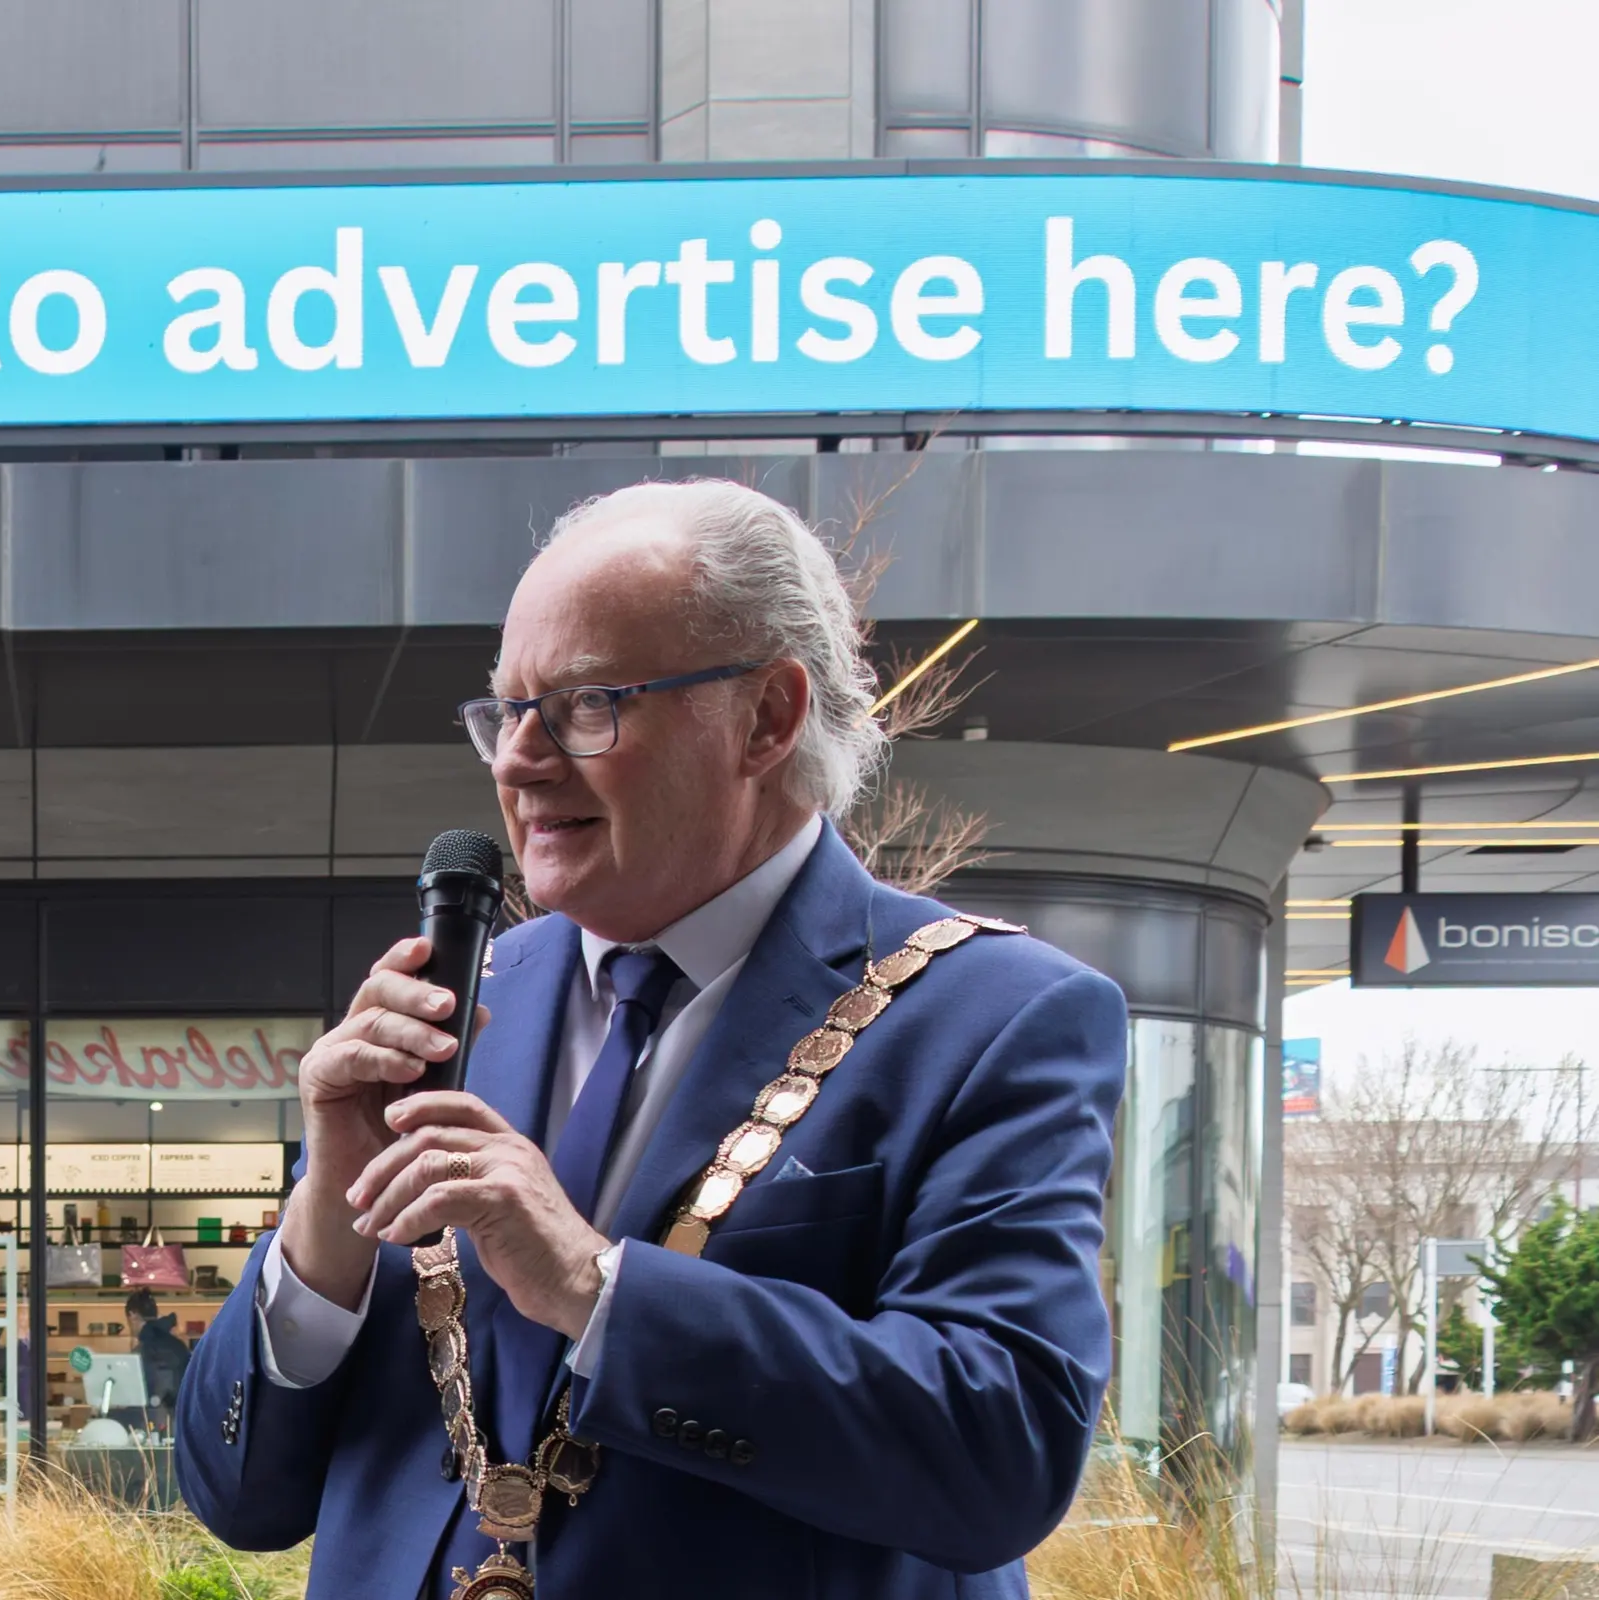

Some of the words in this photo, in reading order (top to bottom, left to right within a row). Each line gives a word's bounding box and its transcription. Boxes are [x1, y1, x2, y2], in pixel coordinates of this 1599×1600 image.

[164, 220, 982, 371] advertise
[1046, 218, 1478, 375] here?
[1437, 917, 1599, 948] bonisc
